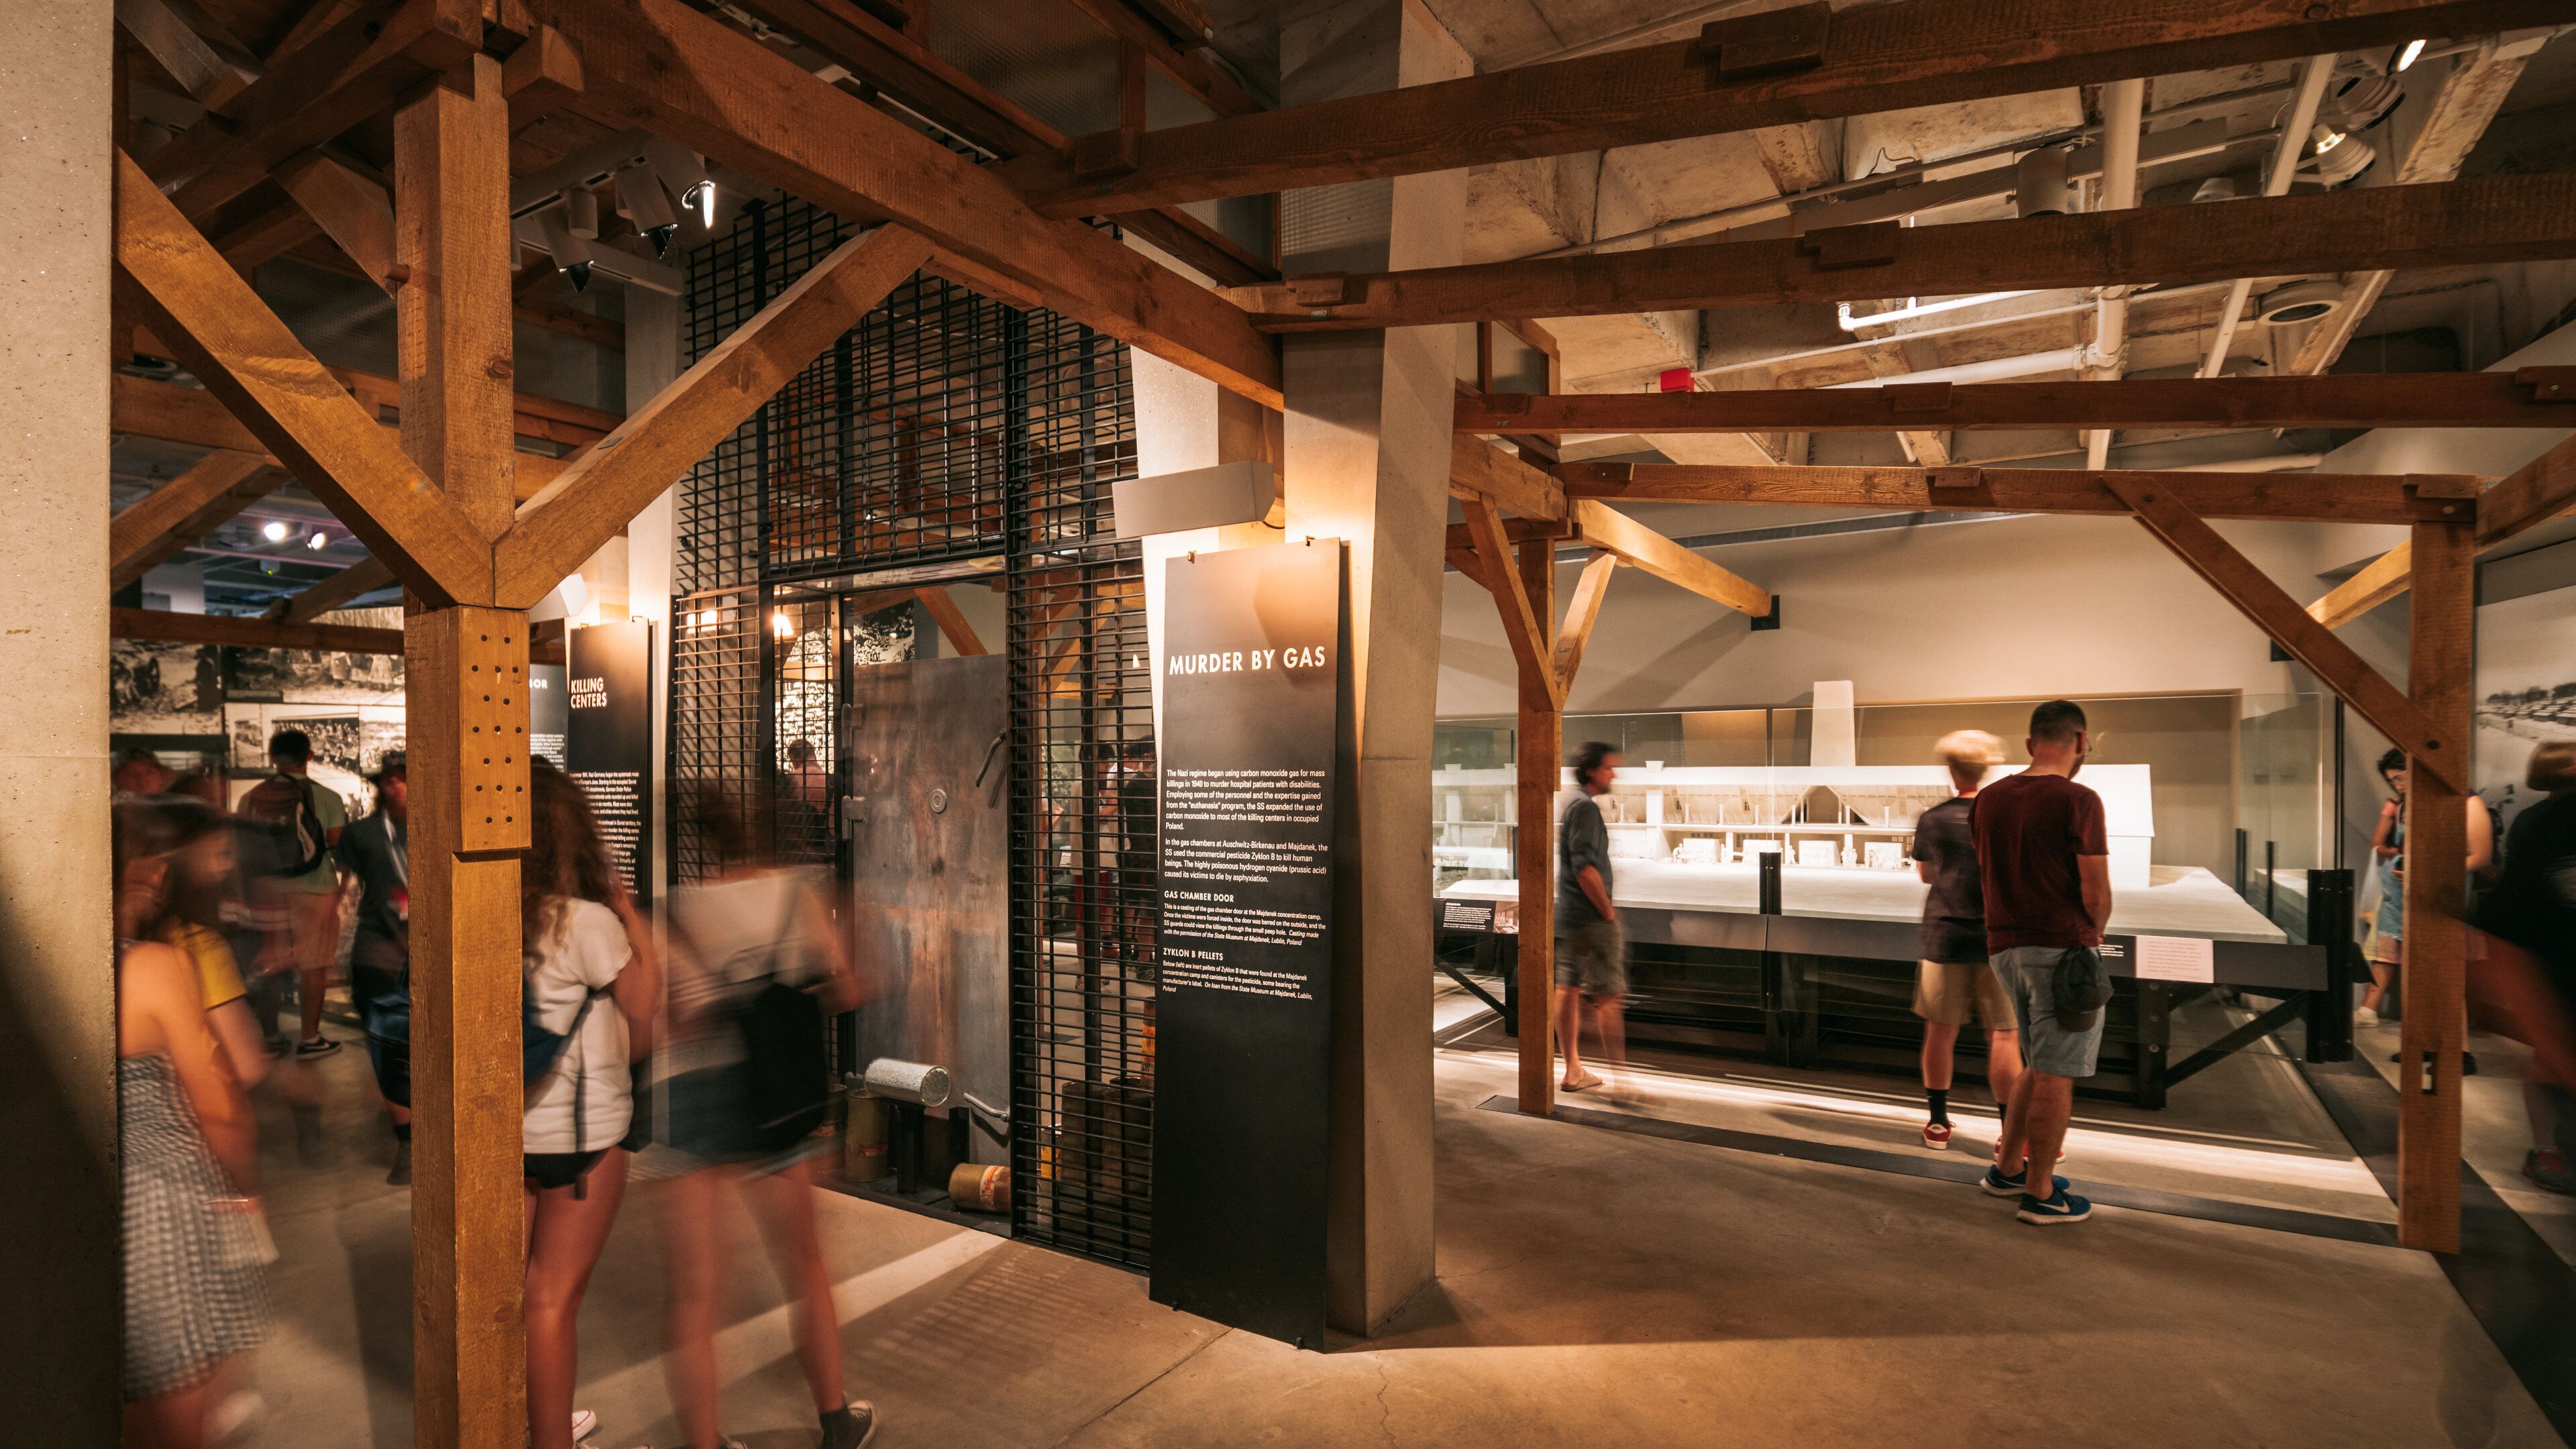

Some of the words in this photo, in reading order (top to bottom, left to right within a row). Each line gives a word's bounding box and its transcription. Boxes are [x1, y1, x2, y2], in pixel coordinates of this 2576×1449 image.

[1169, 651, 1243, 675] MURDER
[1252, 649, 1275, 670] BY
[1283, 646, 1326, 668] GAS
[571, 677, 604, 694] KILLING
[570, 692, 607, 709] CENTERS
[1189, 769, 1207, 777] regime
[1208, 769, 1224, 777] began
[1224, 769, 1239, 777] using
[1167, 780, 1184, 788] killings
[1230, 780, 1251, 789] hospital
[1252, 781, 1274, 789] patients
[1167, 791, 1193, 800] Employing
[1225, 792, 1251, 800] personnel
[1274, 792, 1300, 800] expertise
[1301, 792, 1321, 800] gained
[1265, 803, 1293, 811] expanded
[1247, 814, 1264, 822] killing
[1293, 815, 1319, 823] occupied
[1222, 841, 1275, 849] Auschwitz-Birkenau
[1288, 843, 1316, 851] Majdanek,
[1226, 852, 1250, 860] pesticide
[1251, 853, 1269, 861] Zyklon
[1165, 859, 1183, 868] beings.
[1194, 861, 1210, 870] highly
[1211, 862, 1238, 870] poisonous
[1239, 863, 1265, 872] hydrogen
[1266, 865, 1287, 873] cyanide
[1289, 865, 1311, 873] (prussic
[1312, 867, 1326, 875] acid)
[1225, 873, 1232, 881] by
[1232, 874, 1269, 883] asphyxiation.
[1180, 892, 1211, 901] CHAMBER
[1214, 894, 1234, 902] DOOR
[1220, 916, 1233, 924] inside,
[1163, 948, 1189, 957] ZYKLON
[1197, 951, 1224, 961] PELLETS
[1285, 973, 1307, 981] Majdanek
